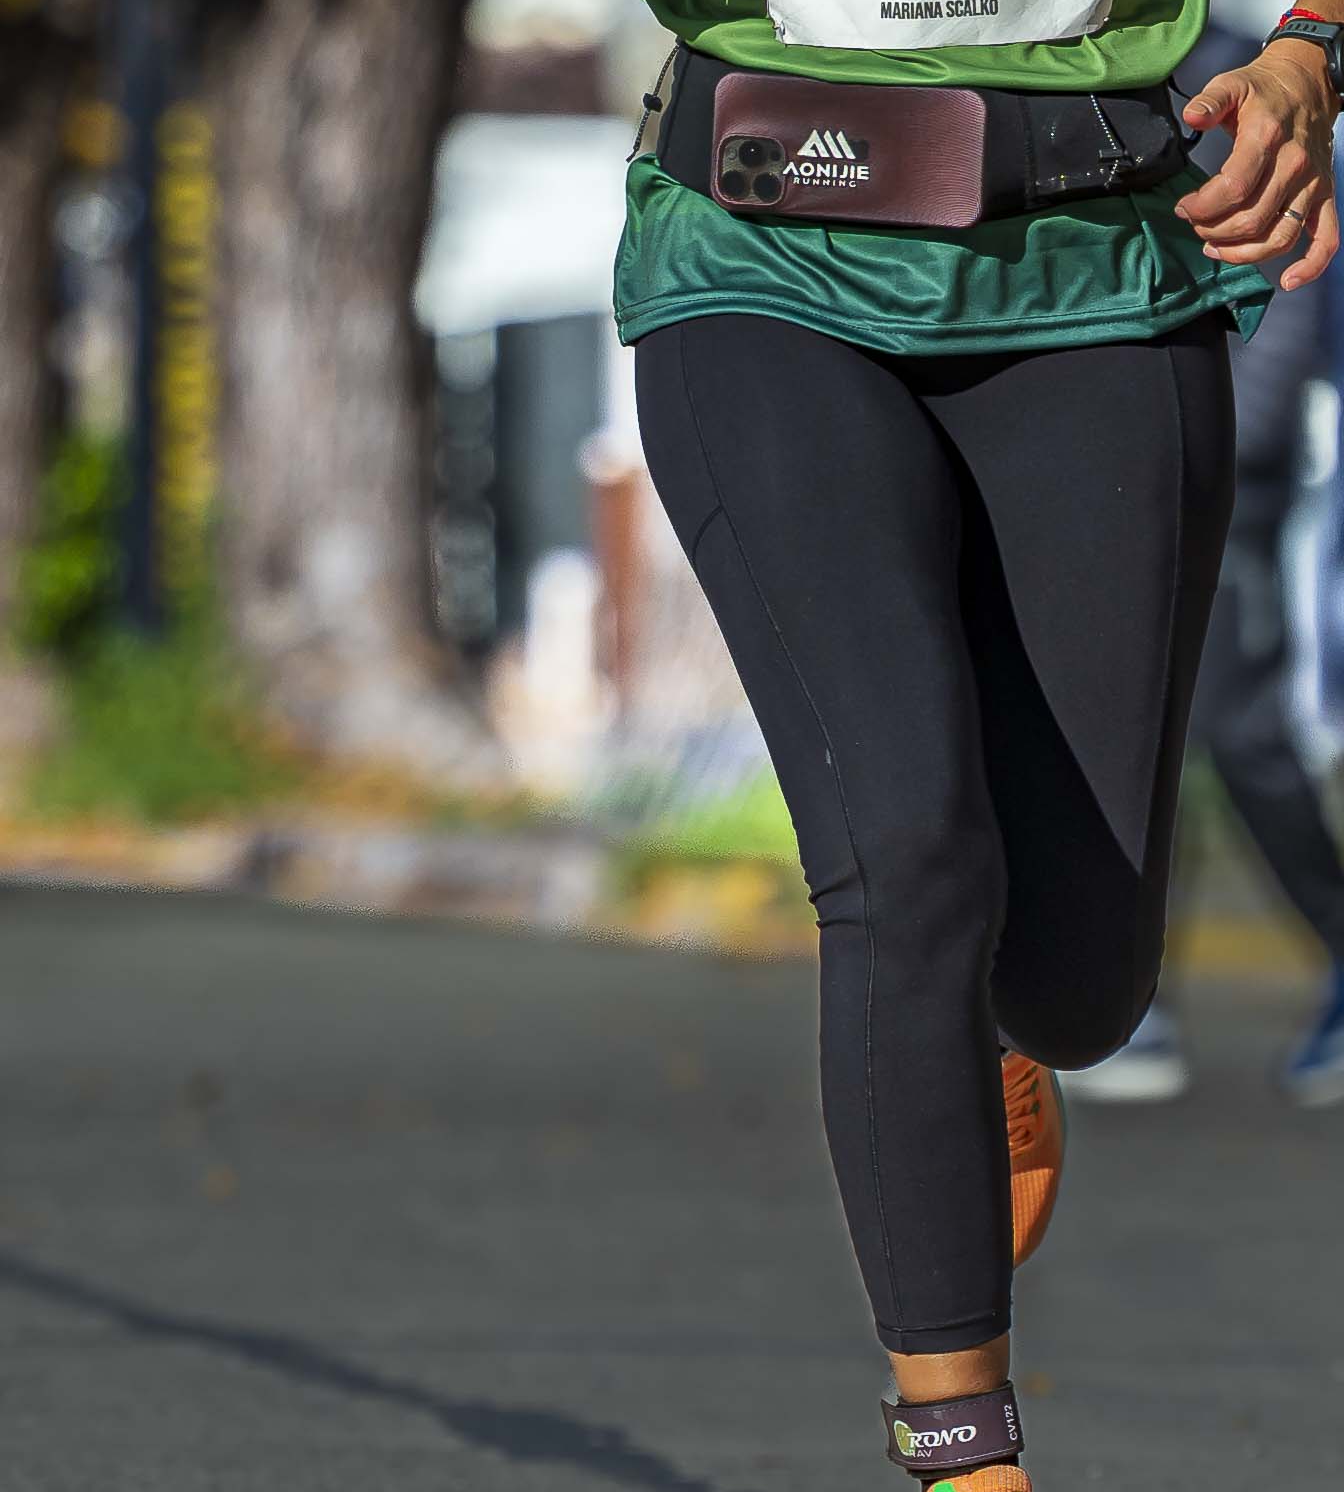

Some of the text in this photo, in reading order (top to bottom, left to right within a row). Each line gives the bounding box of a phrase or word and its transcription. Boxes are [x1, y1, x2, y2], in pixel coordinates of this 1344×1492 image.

[880, 1, 943, 20] MARIANA
[782, 161, 870, 181] AONIJIE
[792, 176, 857, 188] RUNNING
[1003, 1403, 1018, 1441] CV122
